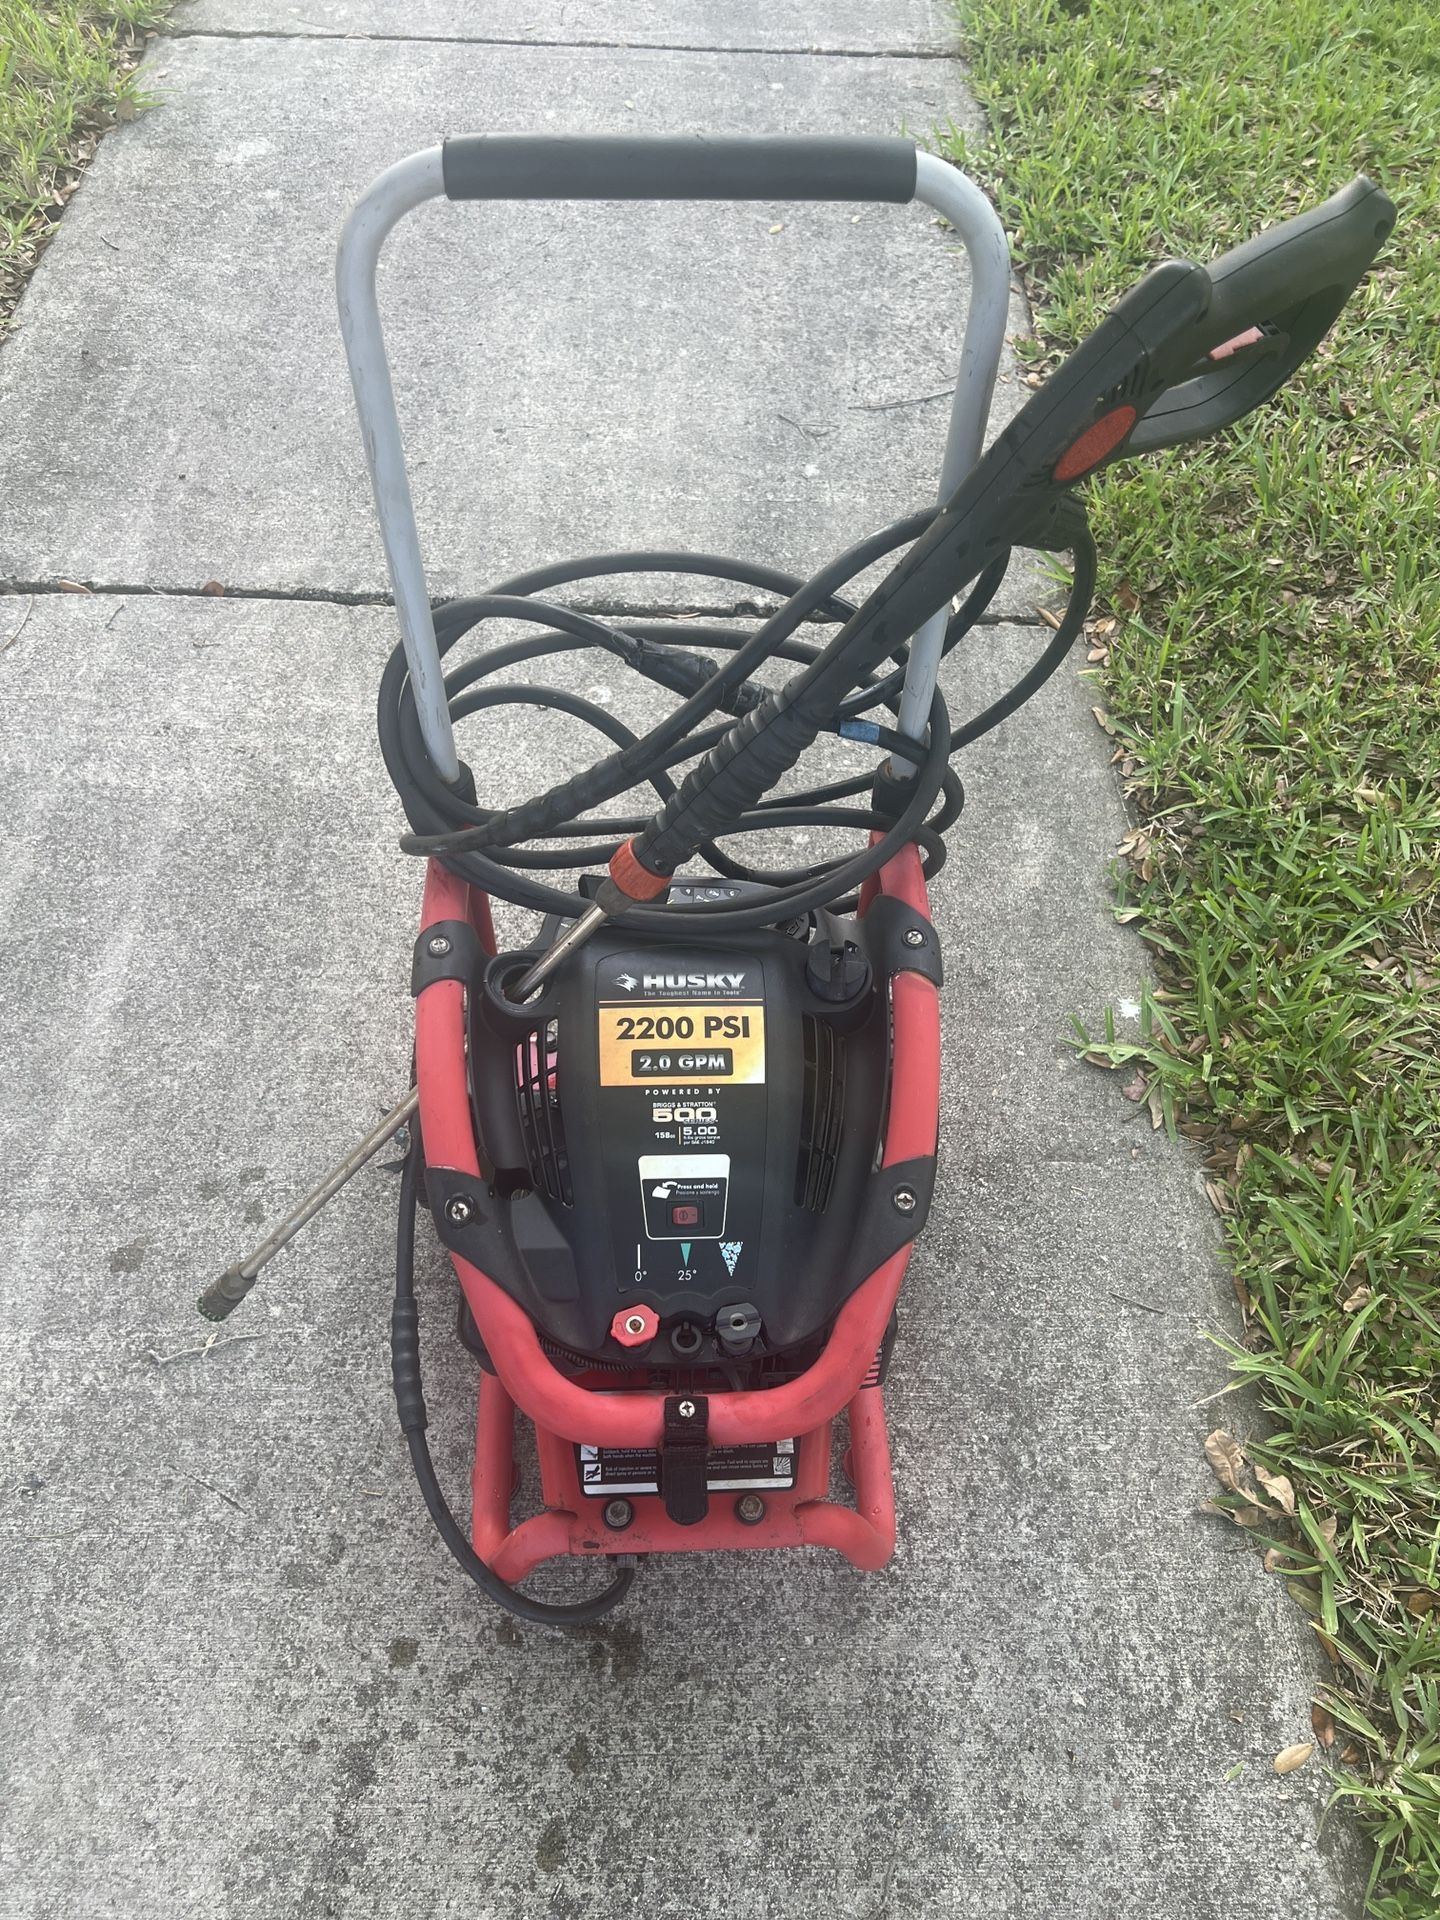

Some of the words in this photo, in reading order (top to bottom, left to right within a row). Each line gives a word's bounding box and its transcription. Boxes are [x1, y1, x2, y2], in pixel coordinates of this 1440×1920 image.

[643, 973, 745, 989] HUSKY
[616, 1016, 694, 1040] 2200
[704, 1015, 750, 1039] PSI
[639, 1054, 671, 1071] 2.0
[678, 1053, 726, 1071] GPM
[652, 1107, 717, 1123] 500
[683, 1126, 718, 1135] 5.00
